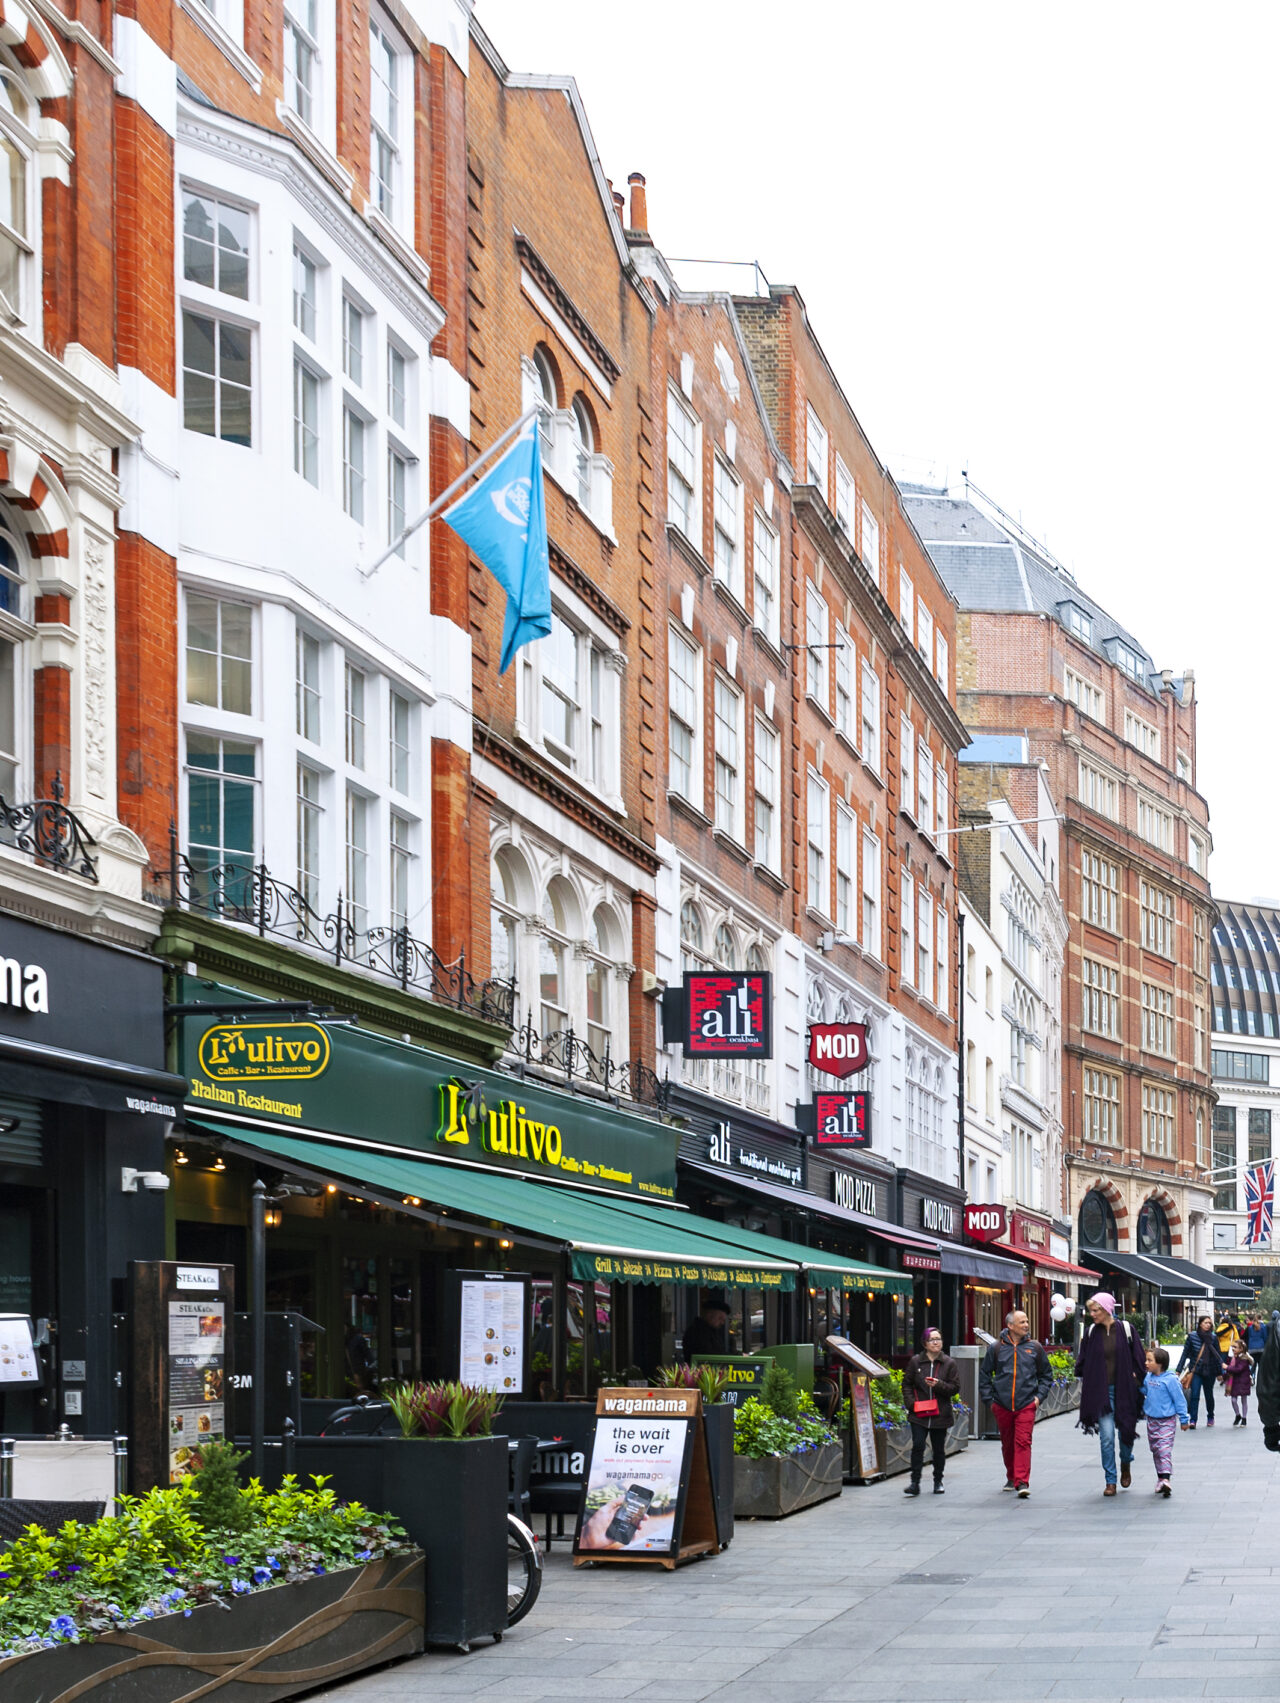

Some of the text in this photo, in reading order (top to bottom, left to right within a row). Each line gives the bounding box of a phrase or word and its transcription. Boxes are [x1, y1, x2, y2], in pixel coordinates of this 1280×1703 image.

[701, 978, 754, 1037] ali
[816, 1034, 859, 1059] MOD
[267, 1065, 311, 1074] Restaurant
[126, 1096, 177, 1117] wagamama
[191, 1078, 302, 1119] Italian Restaurant
[825, 1096, 859, 1134] ali
[710, 1121, 731, 1165] ali
[835, 1171, 877, 1216] MOD PIZZA
[923, 1197, 953, 1234] MOD PIZZA
[968, 1211, 1000, 1230] MOD
[595, 1256, 612, 1273] Grill
[906, 1256, 940, 1269] SUPERFAST
[605, 1398, 687, 1414] wagamama
[613, 1427, 670, 1440] the wait
[614, 1441, 664, 1454] is over
